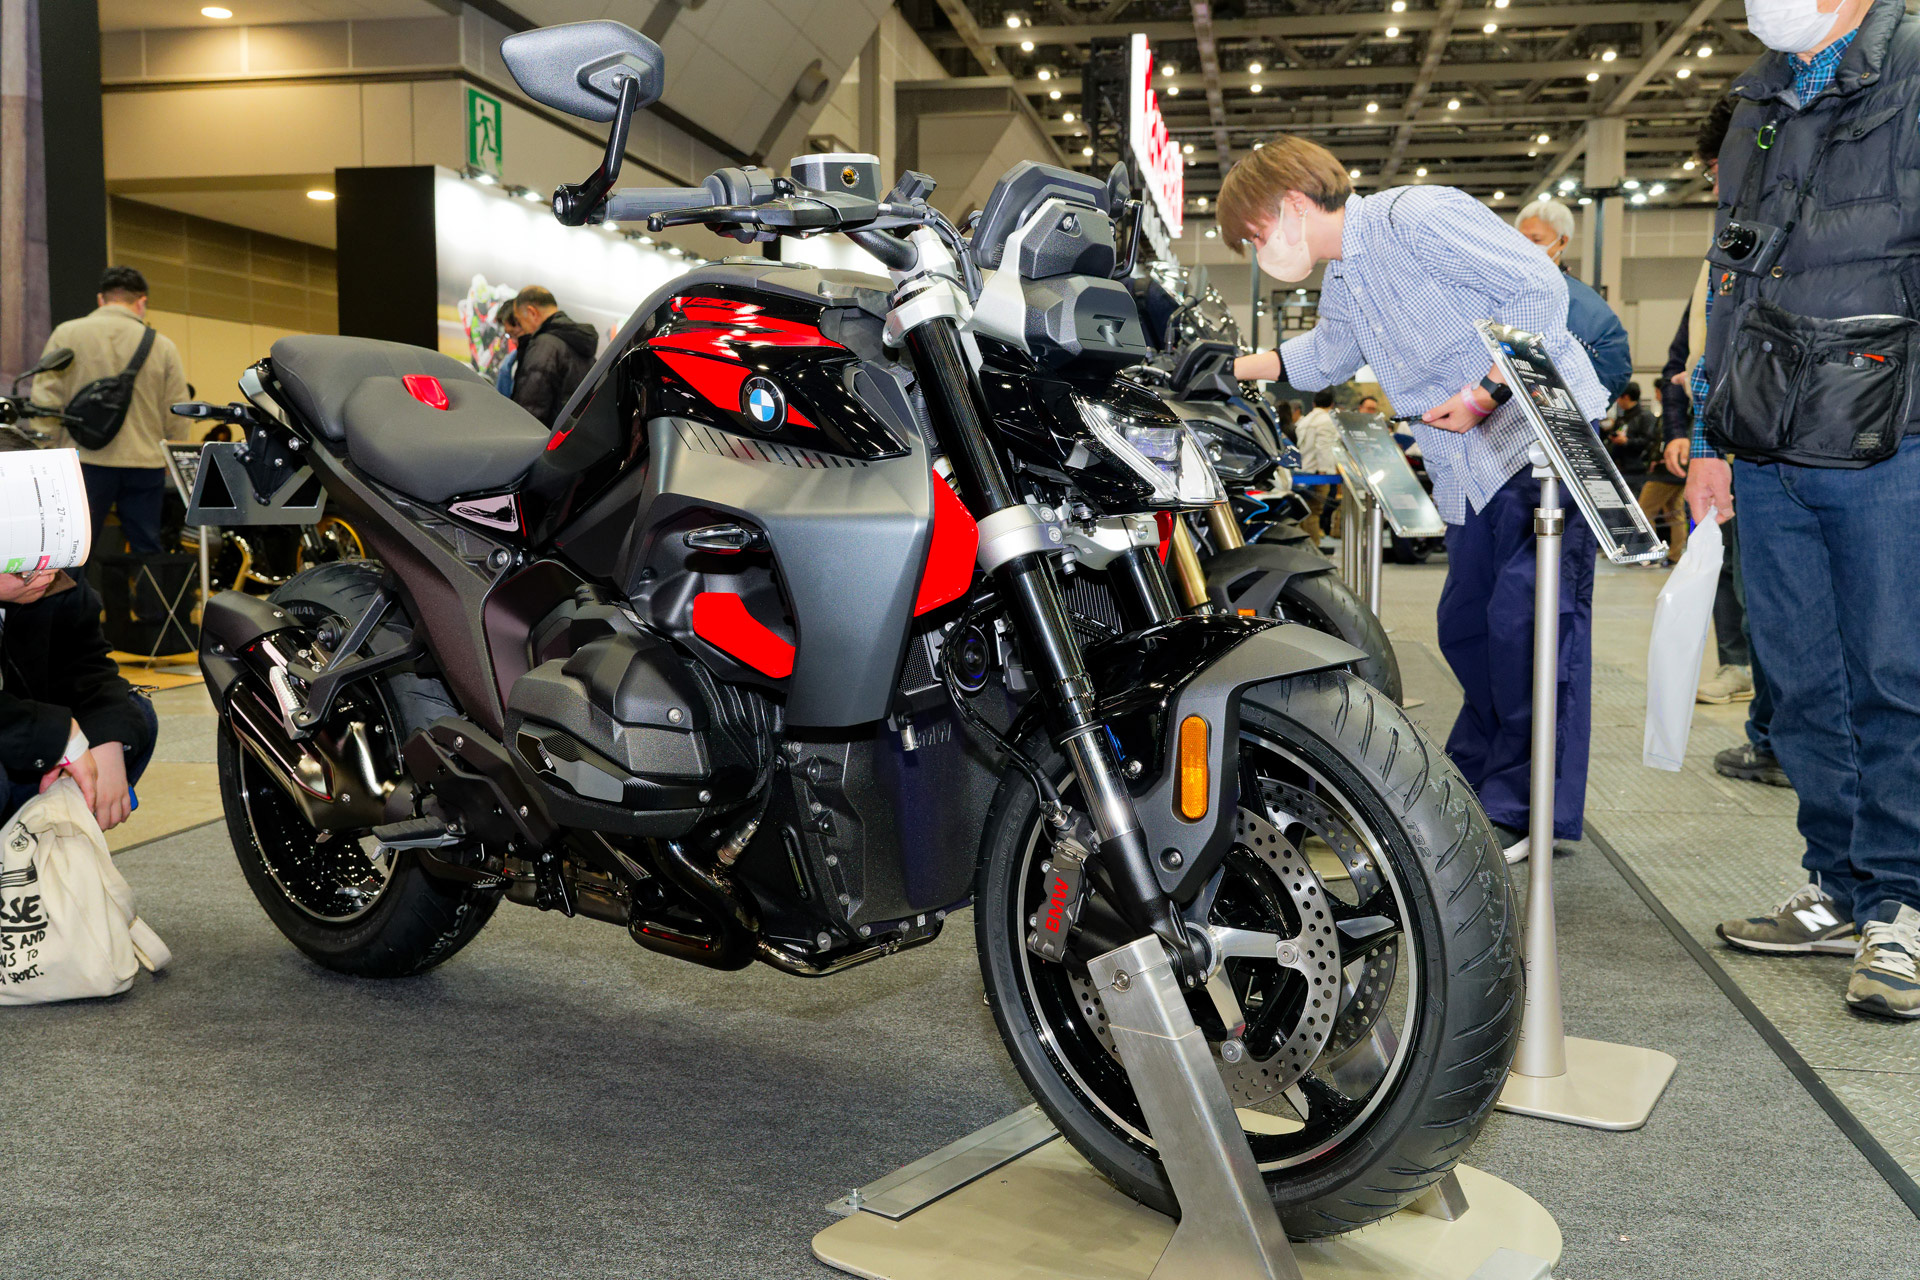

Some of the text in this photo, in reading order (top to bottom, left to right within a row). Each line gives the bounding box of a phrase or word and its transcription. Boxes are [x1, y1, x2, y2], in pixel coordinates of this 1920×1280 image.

[745, 379, 780, 399] BMW
[1045, 876, 1069, 933] BMW
[1792, 903, 1839, 933] N
[20, 930, 46, 949] AND
[27, 949, 39, 961] TO
